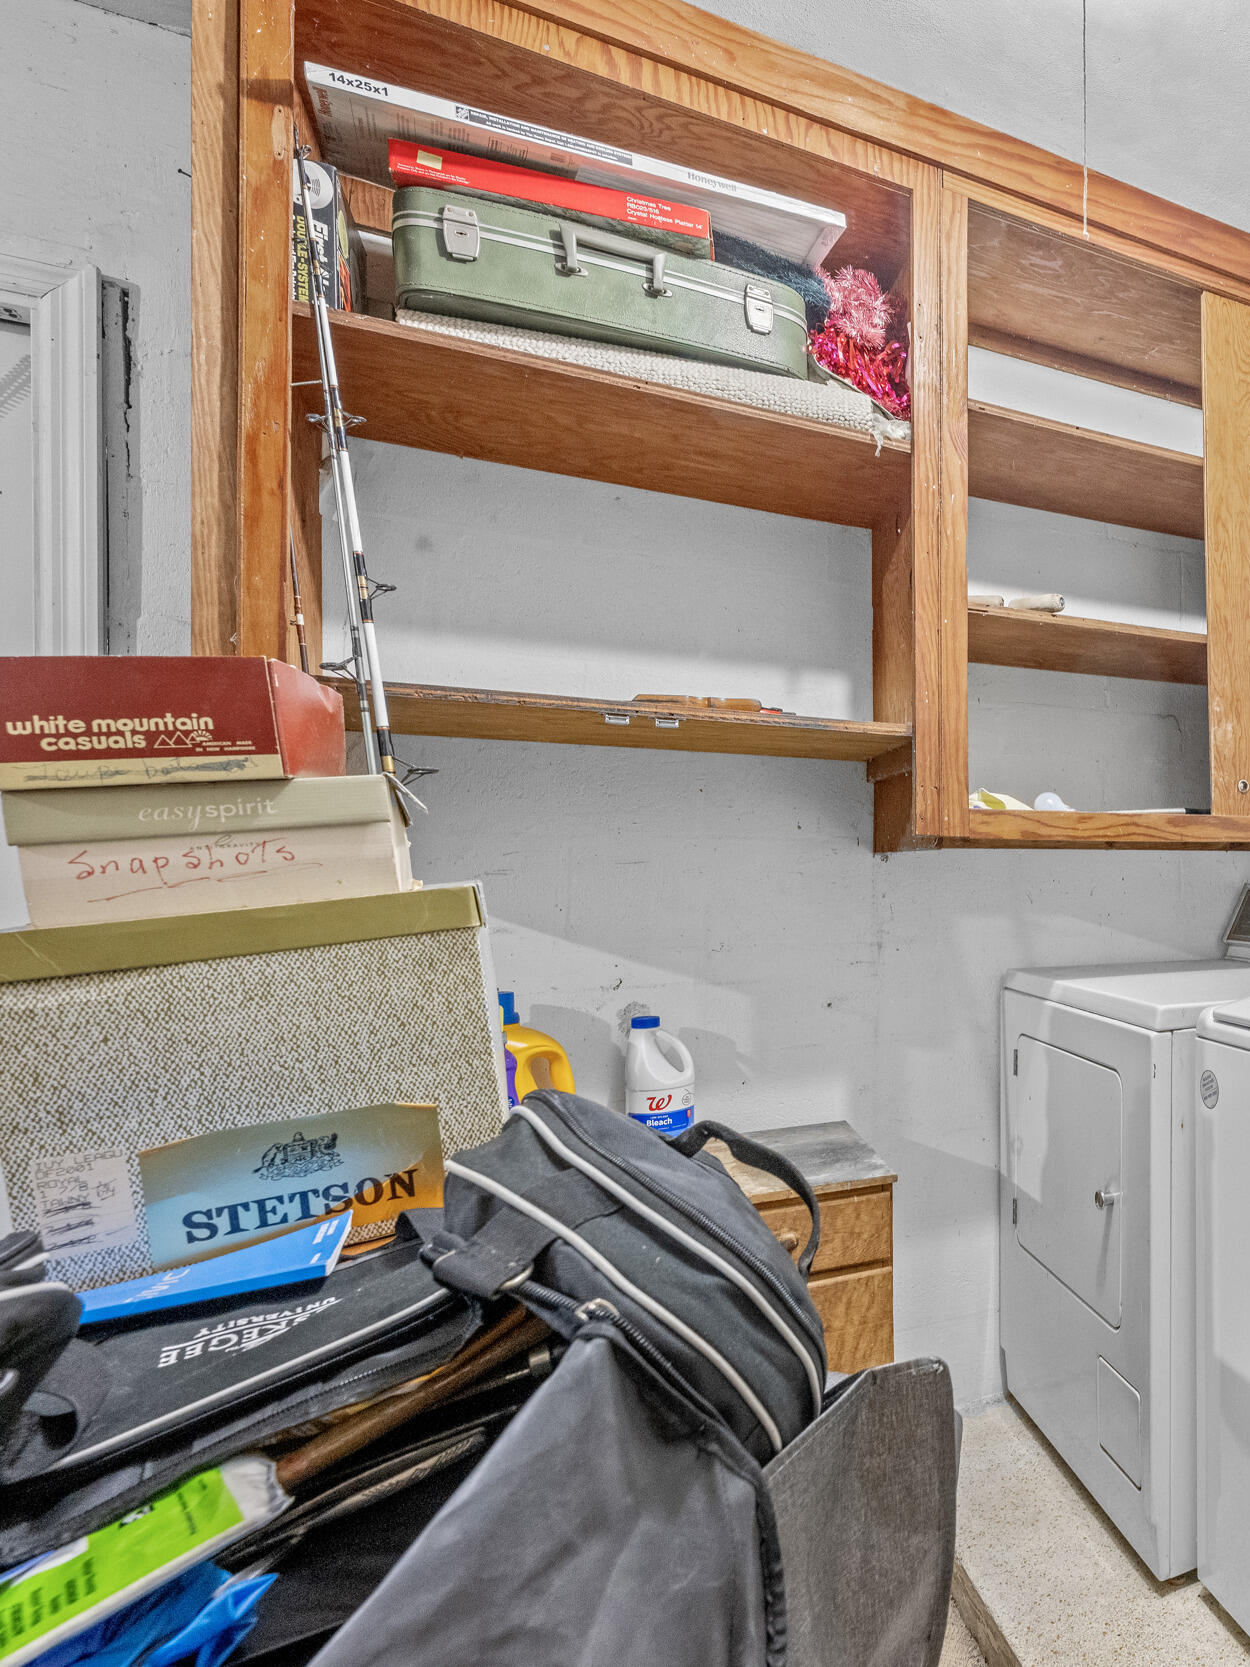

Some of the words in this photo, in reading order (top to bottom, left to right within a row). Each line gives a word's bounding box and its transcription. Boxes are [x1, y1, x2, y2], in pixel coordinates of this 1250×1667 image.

[328, 72, 389, 97] 14x25x1
[687, 172, 737, 193] Honeywell
[626, 208, 648, 219] Crystal
[627, 196, 657, 208] Christmas
[658, 203, 672, 212] Tree
[296, 215, 309, 303] DOULE-SYSTEM
[6, 715, 86, 736] white
[92, 713, 214, 733] mountain
[40, 731, 146, 751] casuals
[138, 798, 280, 831] easyspirit
[646, 1117, 673, 1127] Bleach
[180, 1168, 420, 1245] STETSON
